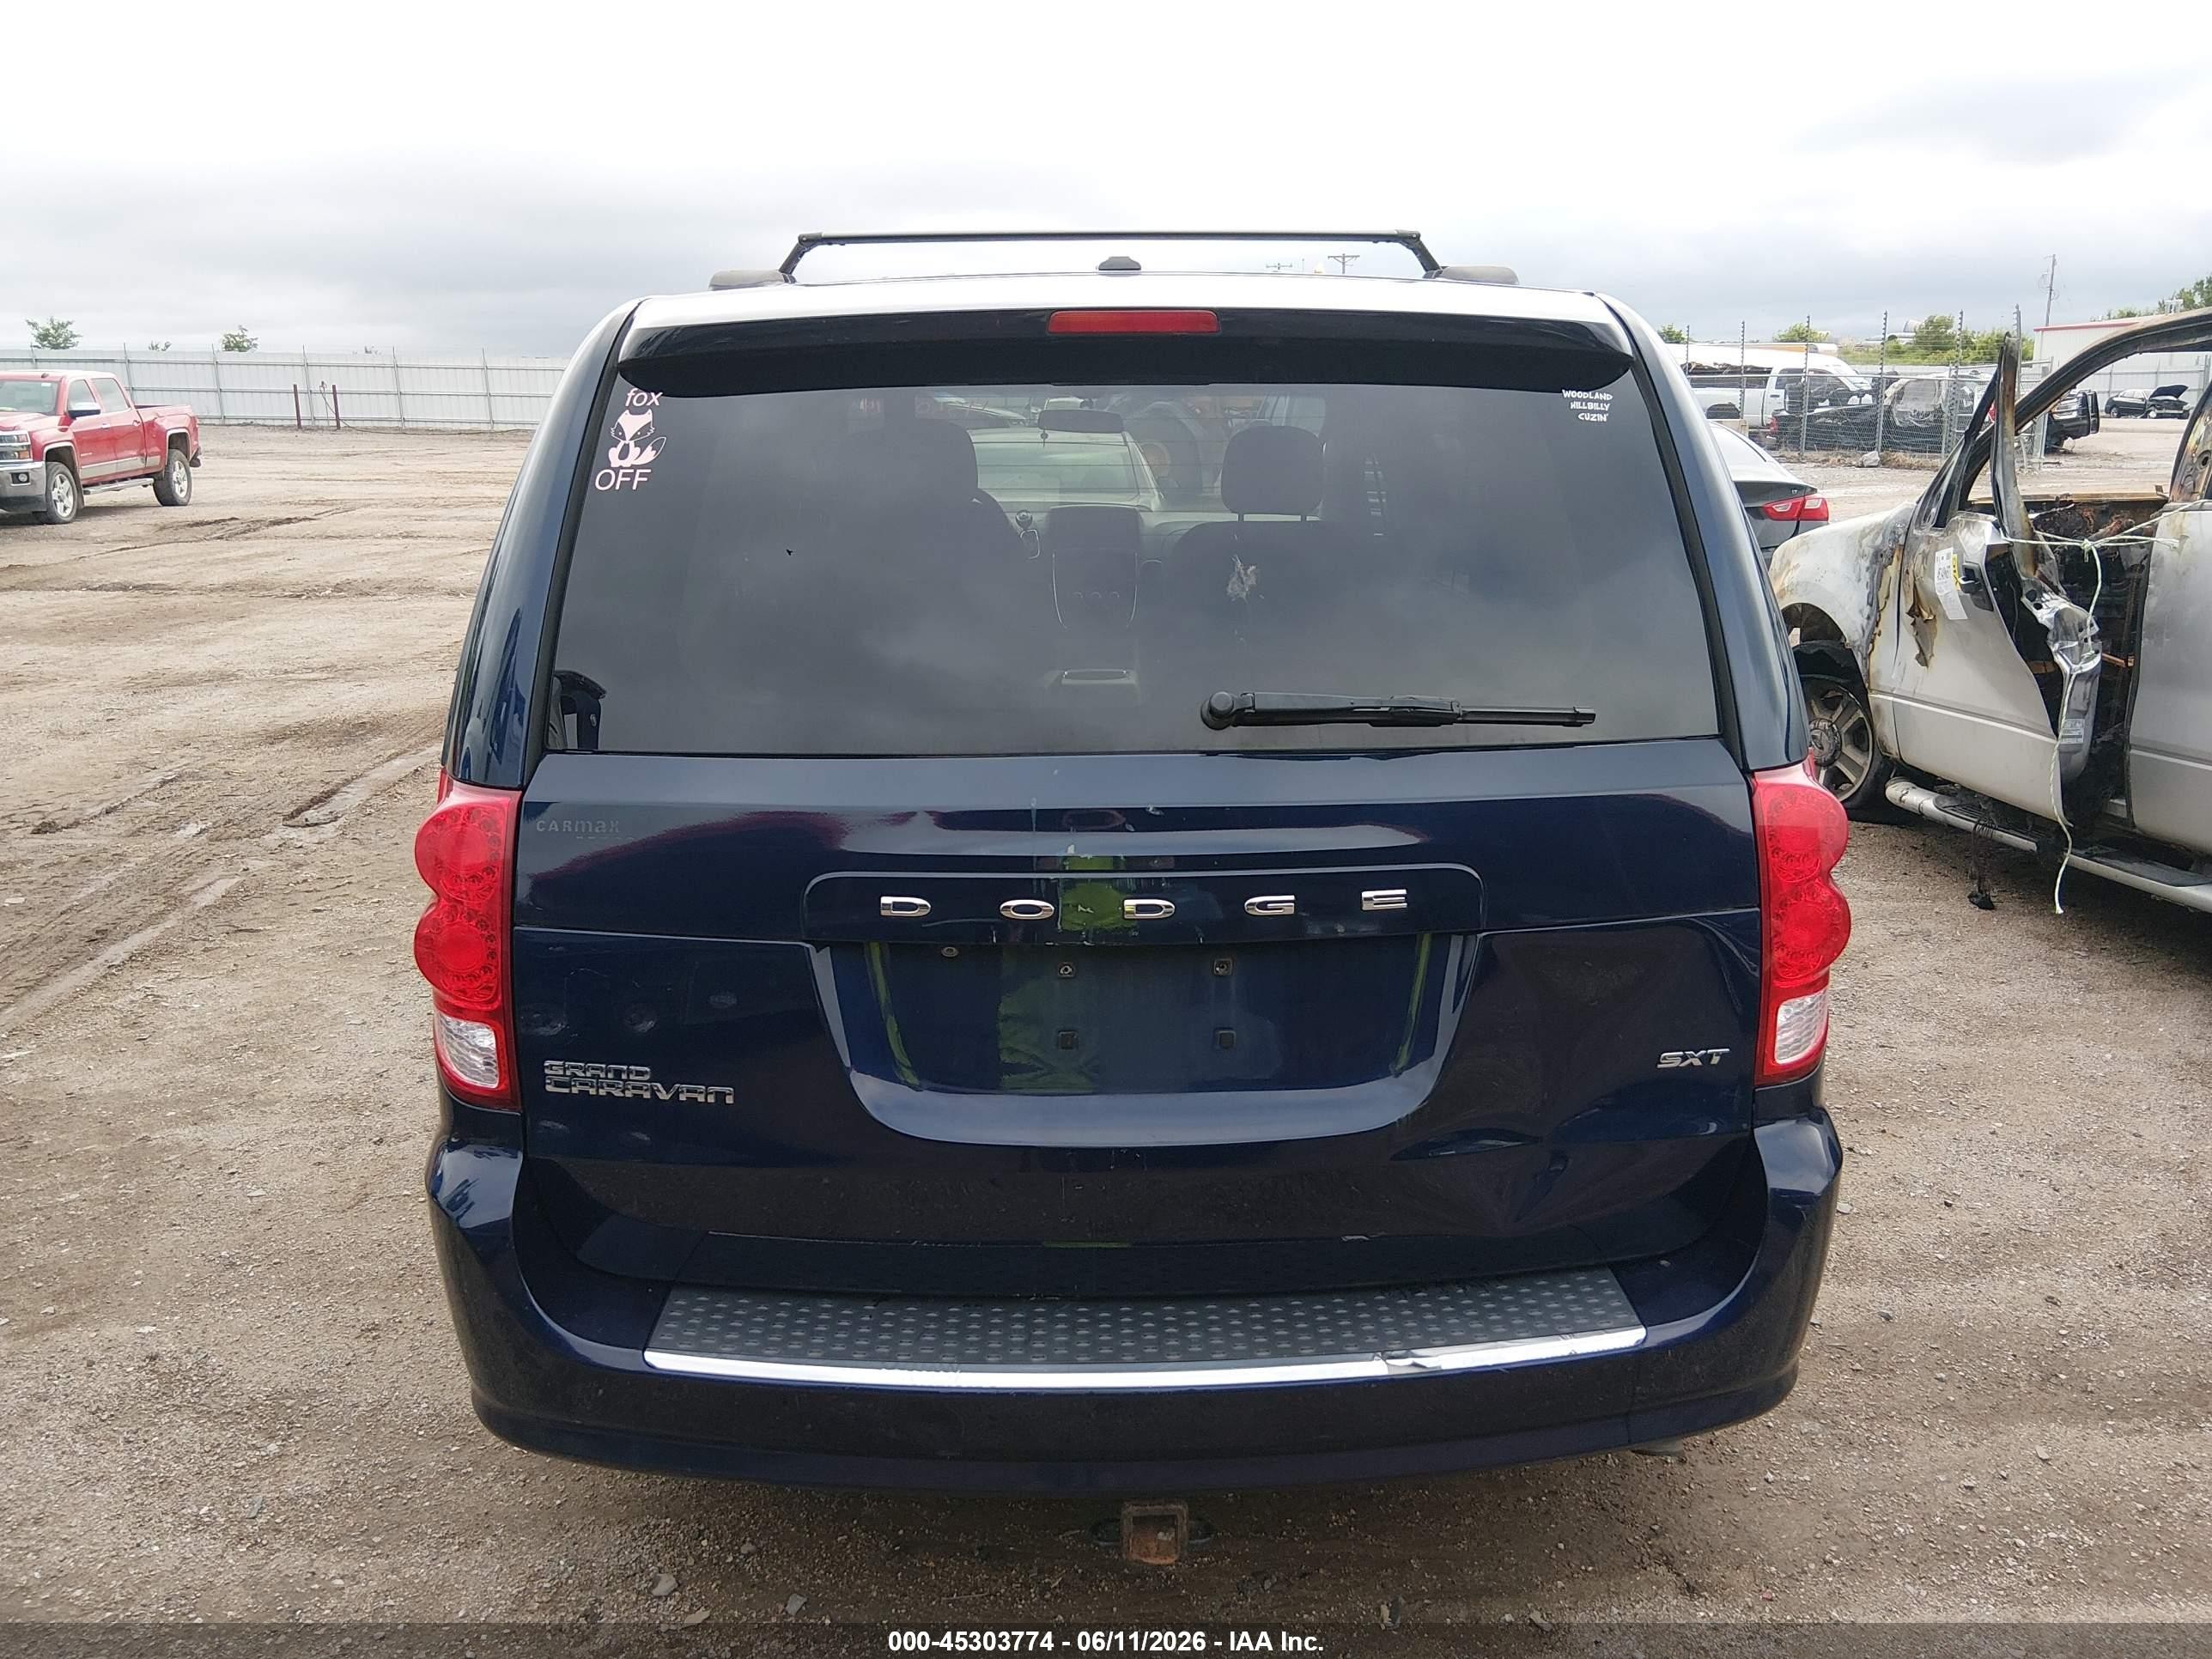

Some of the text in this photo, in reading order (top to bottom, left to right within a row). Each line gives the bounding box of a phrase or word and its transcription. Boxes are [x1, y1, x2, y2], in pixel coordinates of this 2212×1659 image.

[625, 388, 663, 406] fox
[1562, 390, 1613, 400] WOODLAND
[1570, 401, 1610, 410] HILLBILLY
[595, 469, 651, 490] OFF
[880, 889, 1407, 919] DODGE
[1656, 1048, 1730, 1068] SXT
